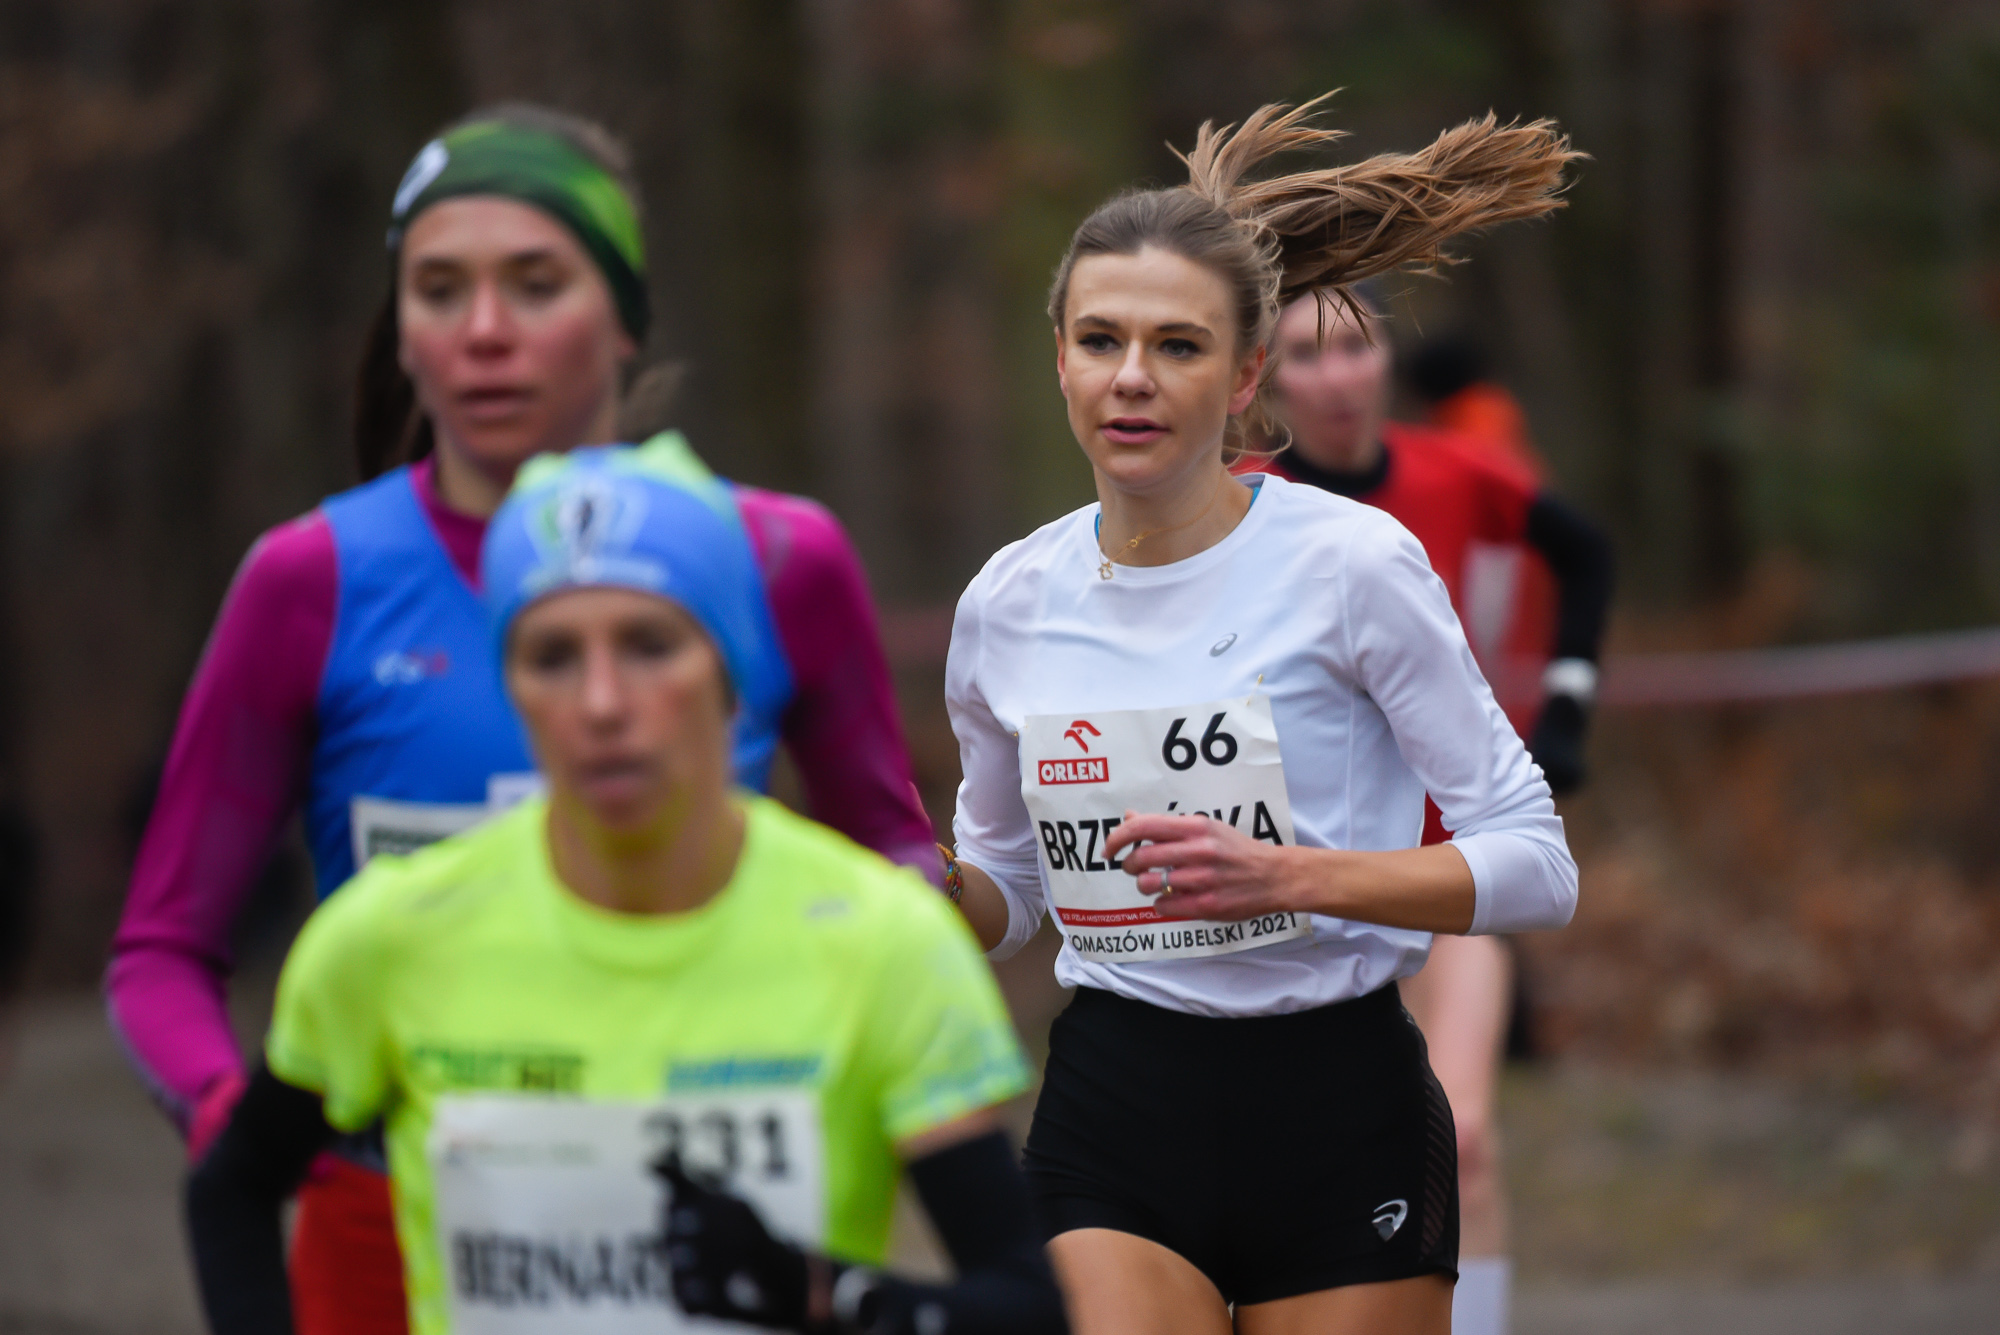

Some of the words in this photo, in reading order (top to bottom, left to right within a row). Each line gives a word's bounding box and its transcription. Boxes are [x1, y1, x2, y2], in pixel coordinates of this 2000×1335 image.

[1161, 711, 1238, 771] 66
[1041, 761, 1104, 782] ORLEN
[1069, 930, 1154, 953] OMASZÓW
[1162, 924, 1244, 949] LUBELSKI
[1250, 912, 1296, 937] 2021
